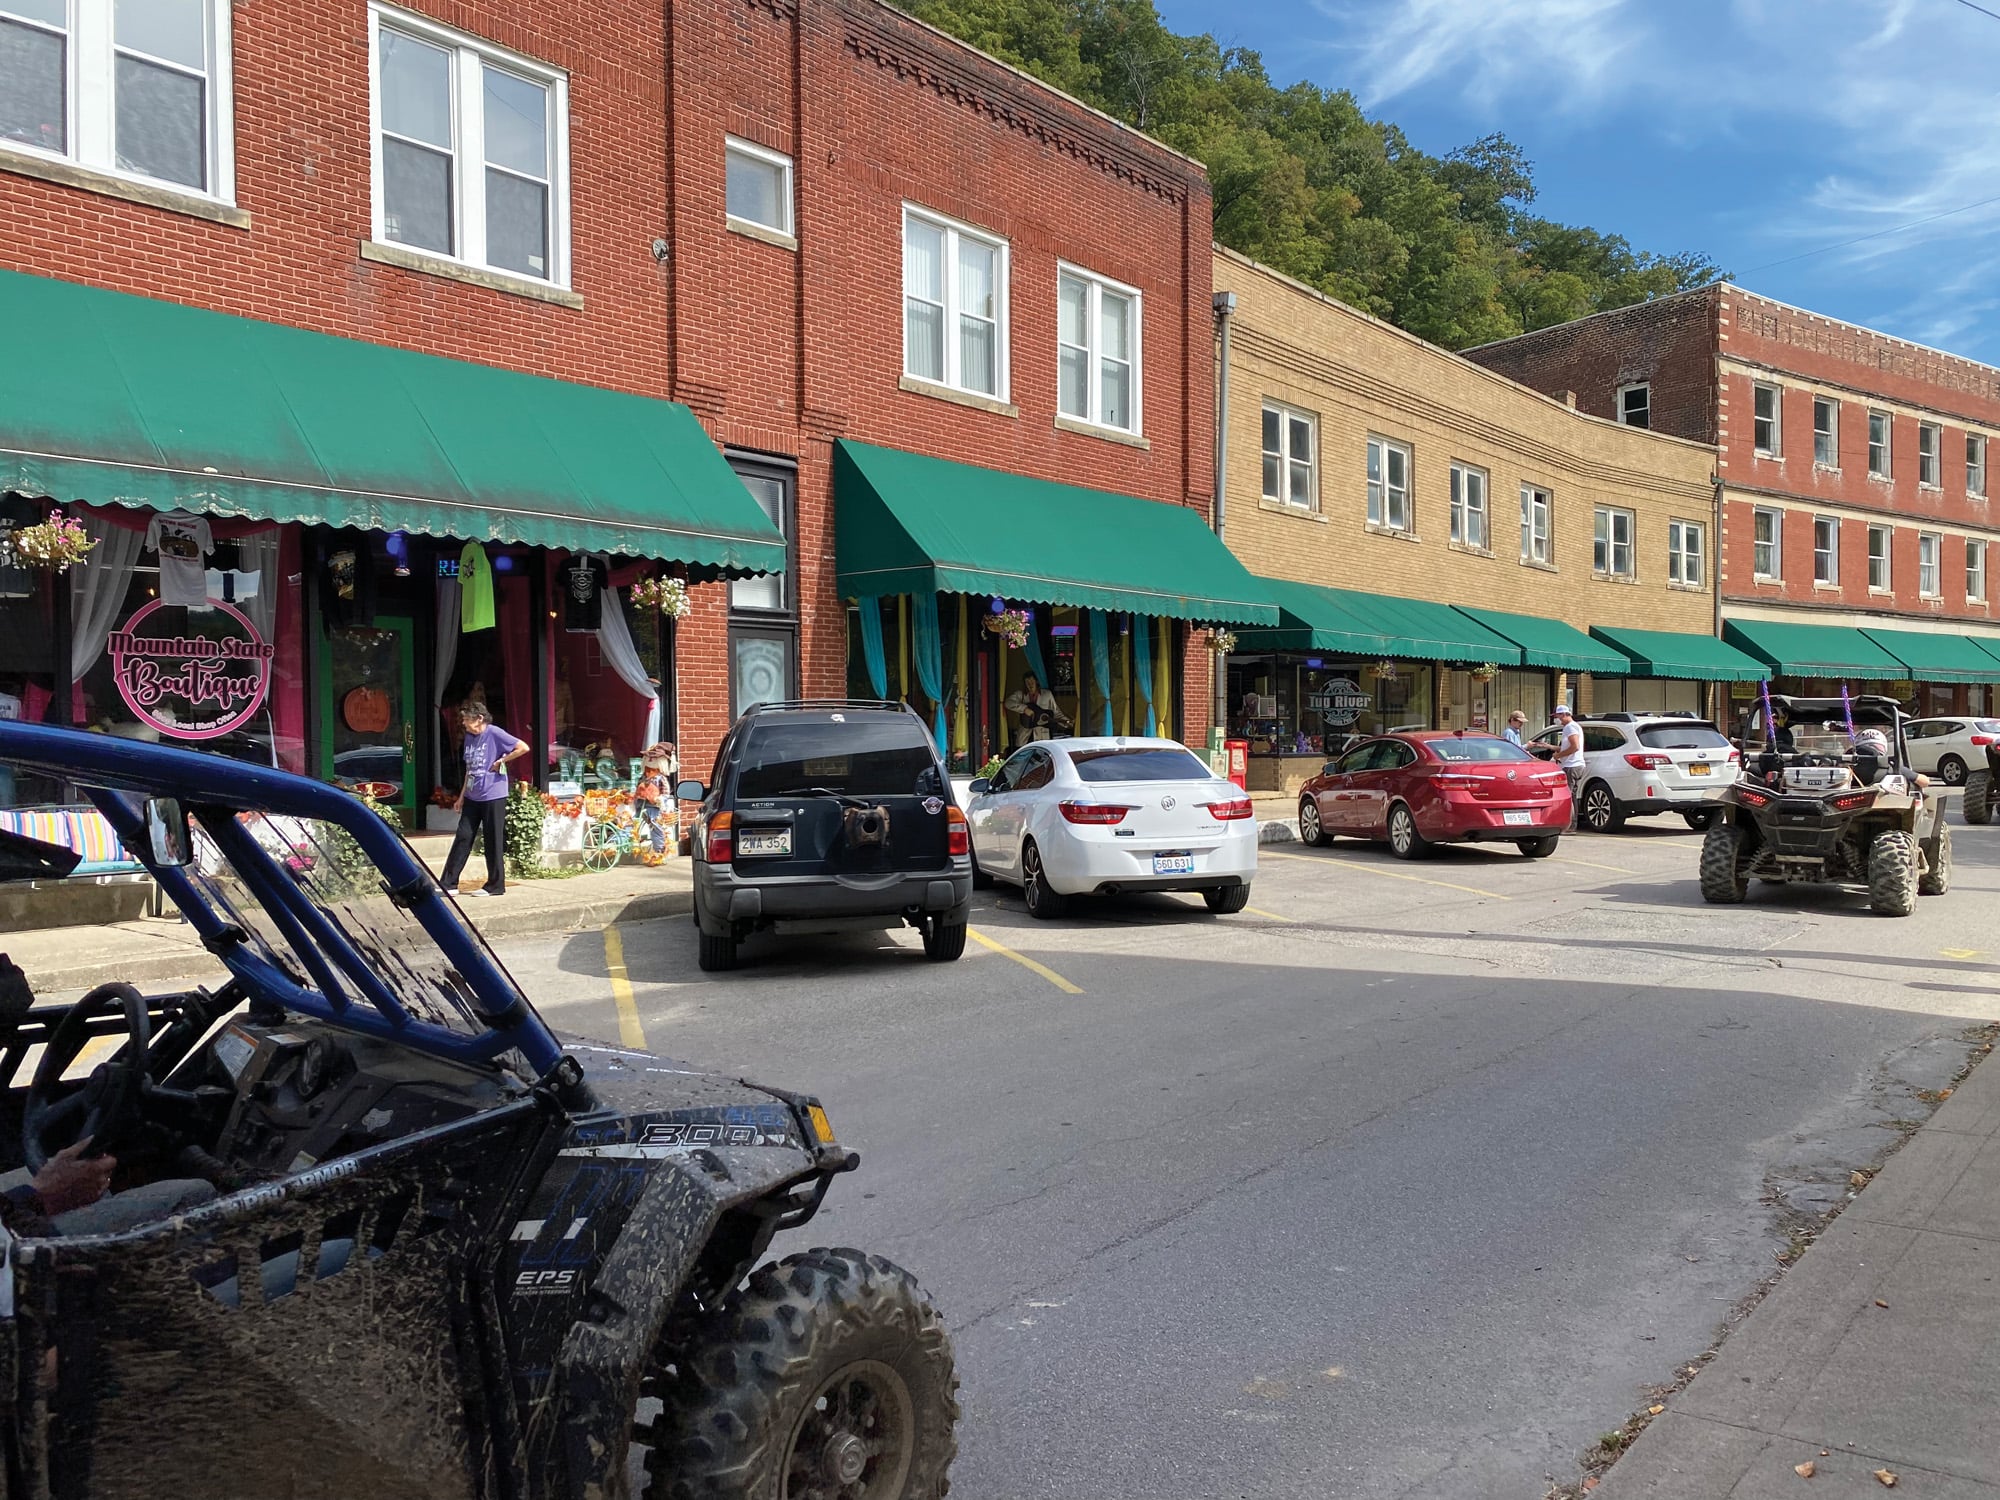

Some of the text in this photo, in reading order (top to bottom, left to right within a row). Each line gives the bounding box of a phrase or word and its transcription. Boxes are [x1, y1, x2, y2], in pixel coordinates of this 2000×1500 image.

[108, 631, 274, 660] Mountain State
[114, 658, 262, 710] Boutique
[1309, 695, 1372, 709] Tug River
[172, 719, 195, 730] Local
[195, 721, 217, 730] Shop
[742, 836, 788, 850] 2WA 352
[1174, 858, 1190, 868] 631
[637, 1124, 758, 1147] 800
[515, 1270, 576, 1285] EPS
